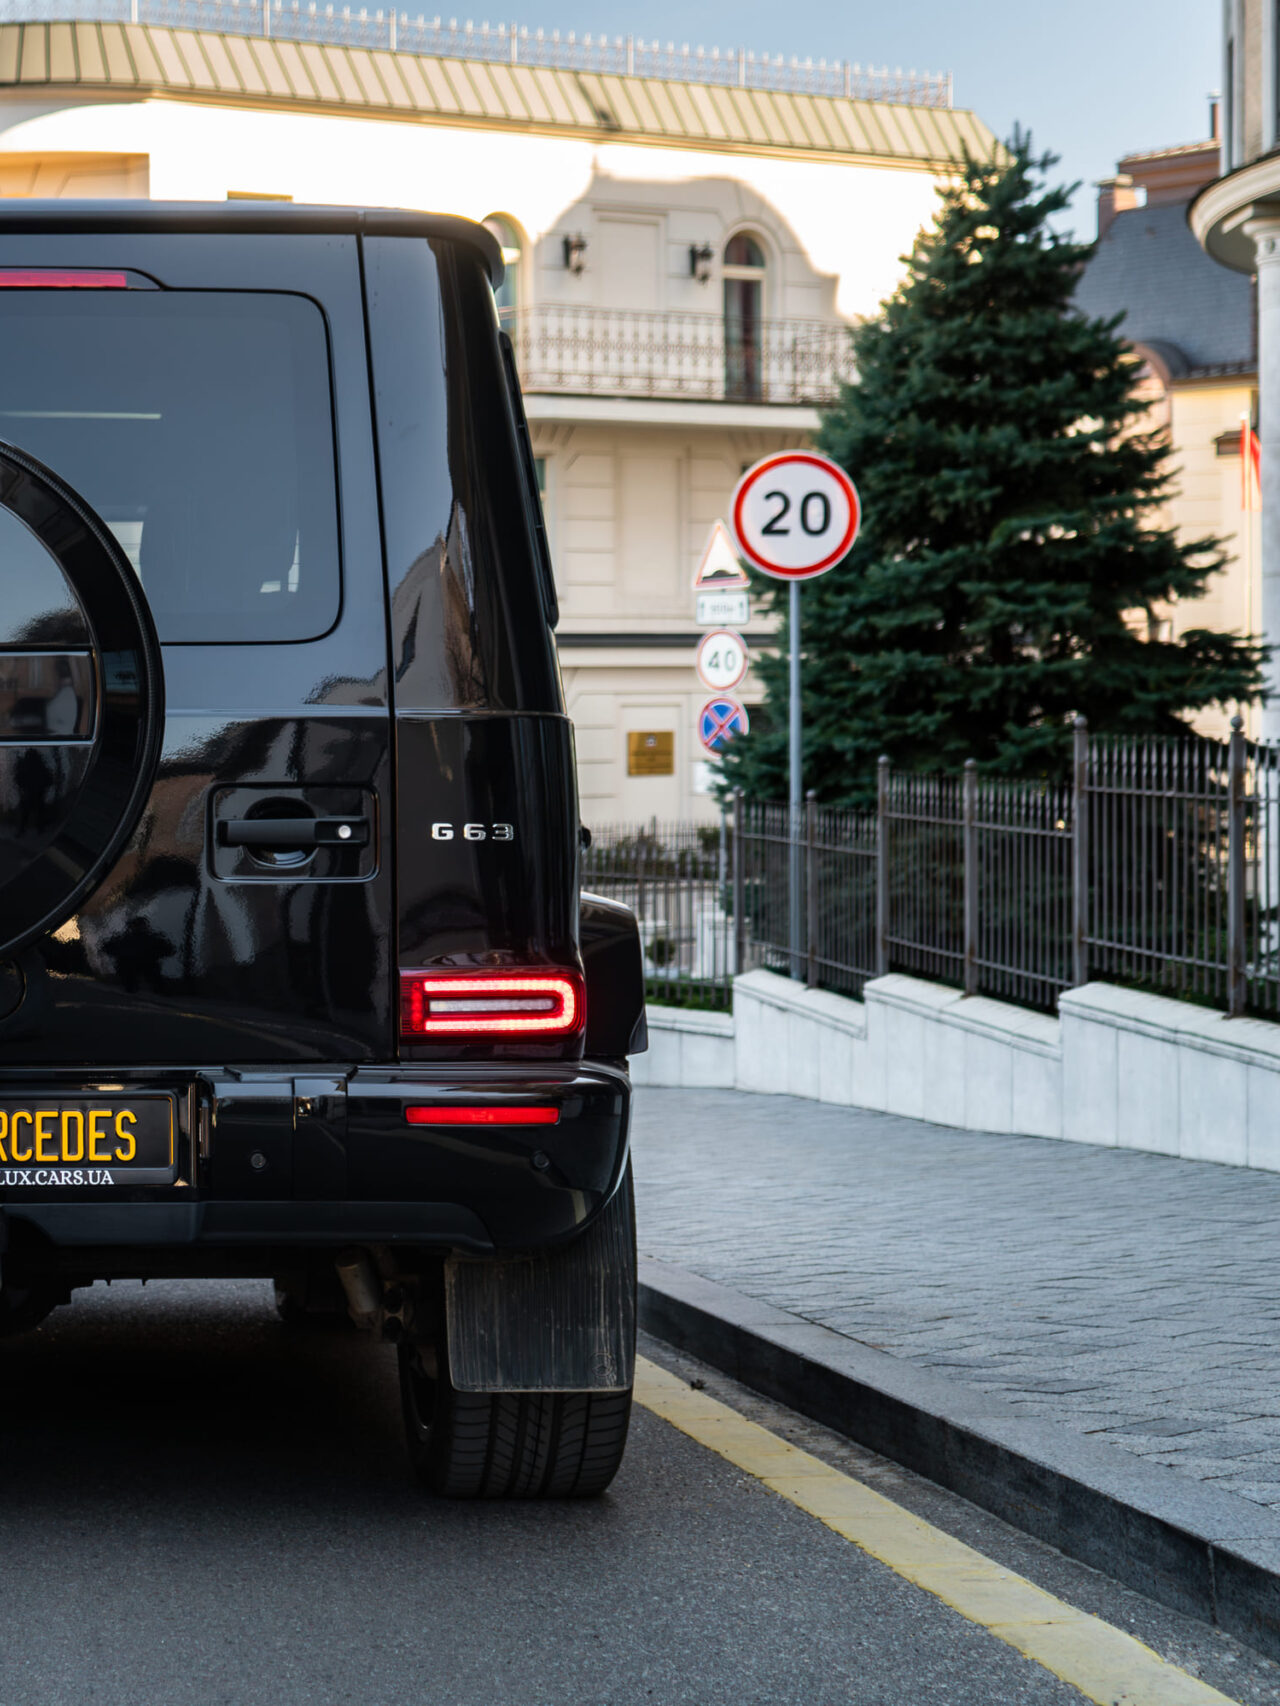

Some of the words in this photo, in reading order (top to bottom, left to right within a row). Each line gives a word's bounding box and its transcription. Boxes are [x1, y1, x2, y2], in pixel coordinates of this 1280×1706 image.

[760, 490, 831, 537] 20
[707, 650, 737, 672] 40
[431, 823, 454, 841] G
[463, 823, 514, 841] 63
